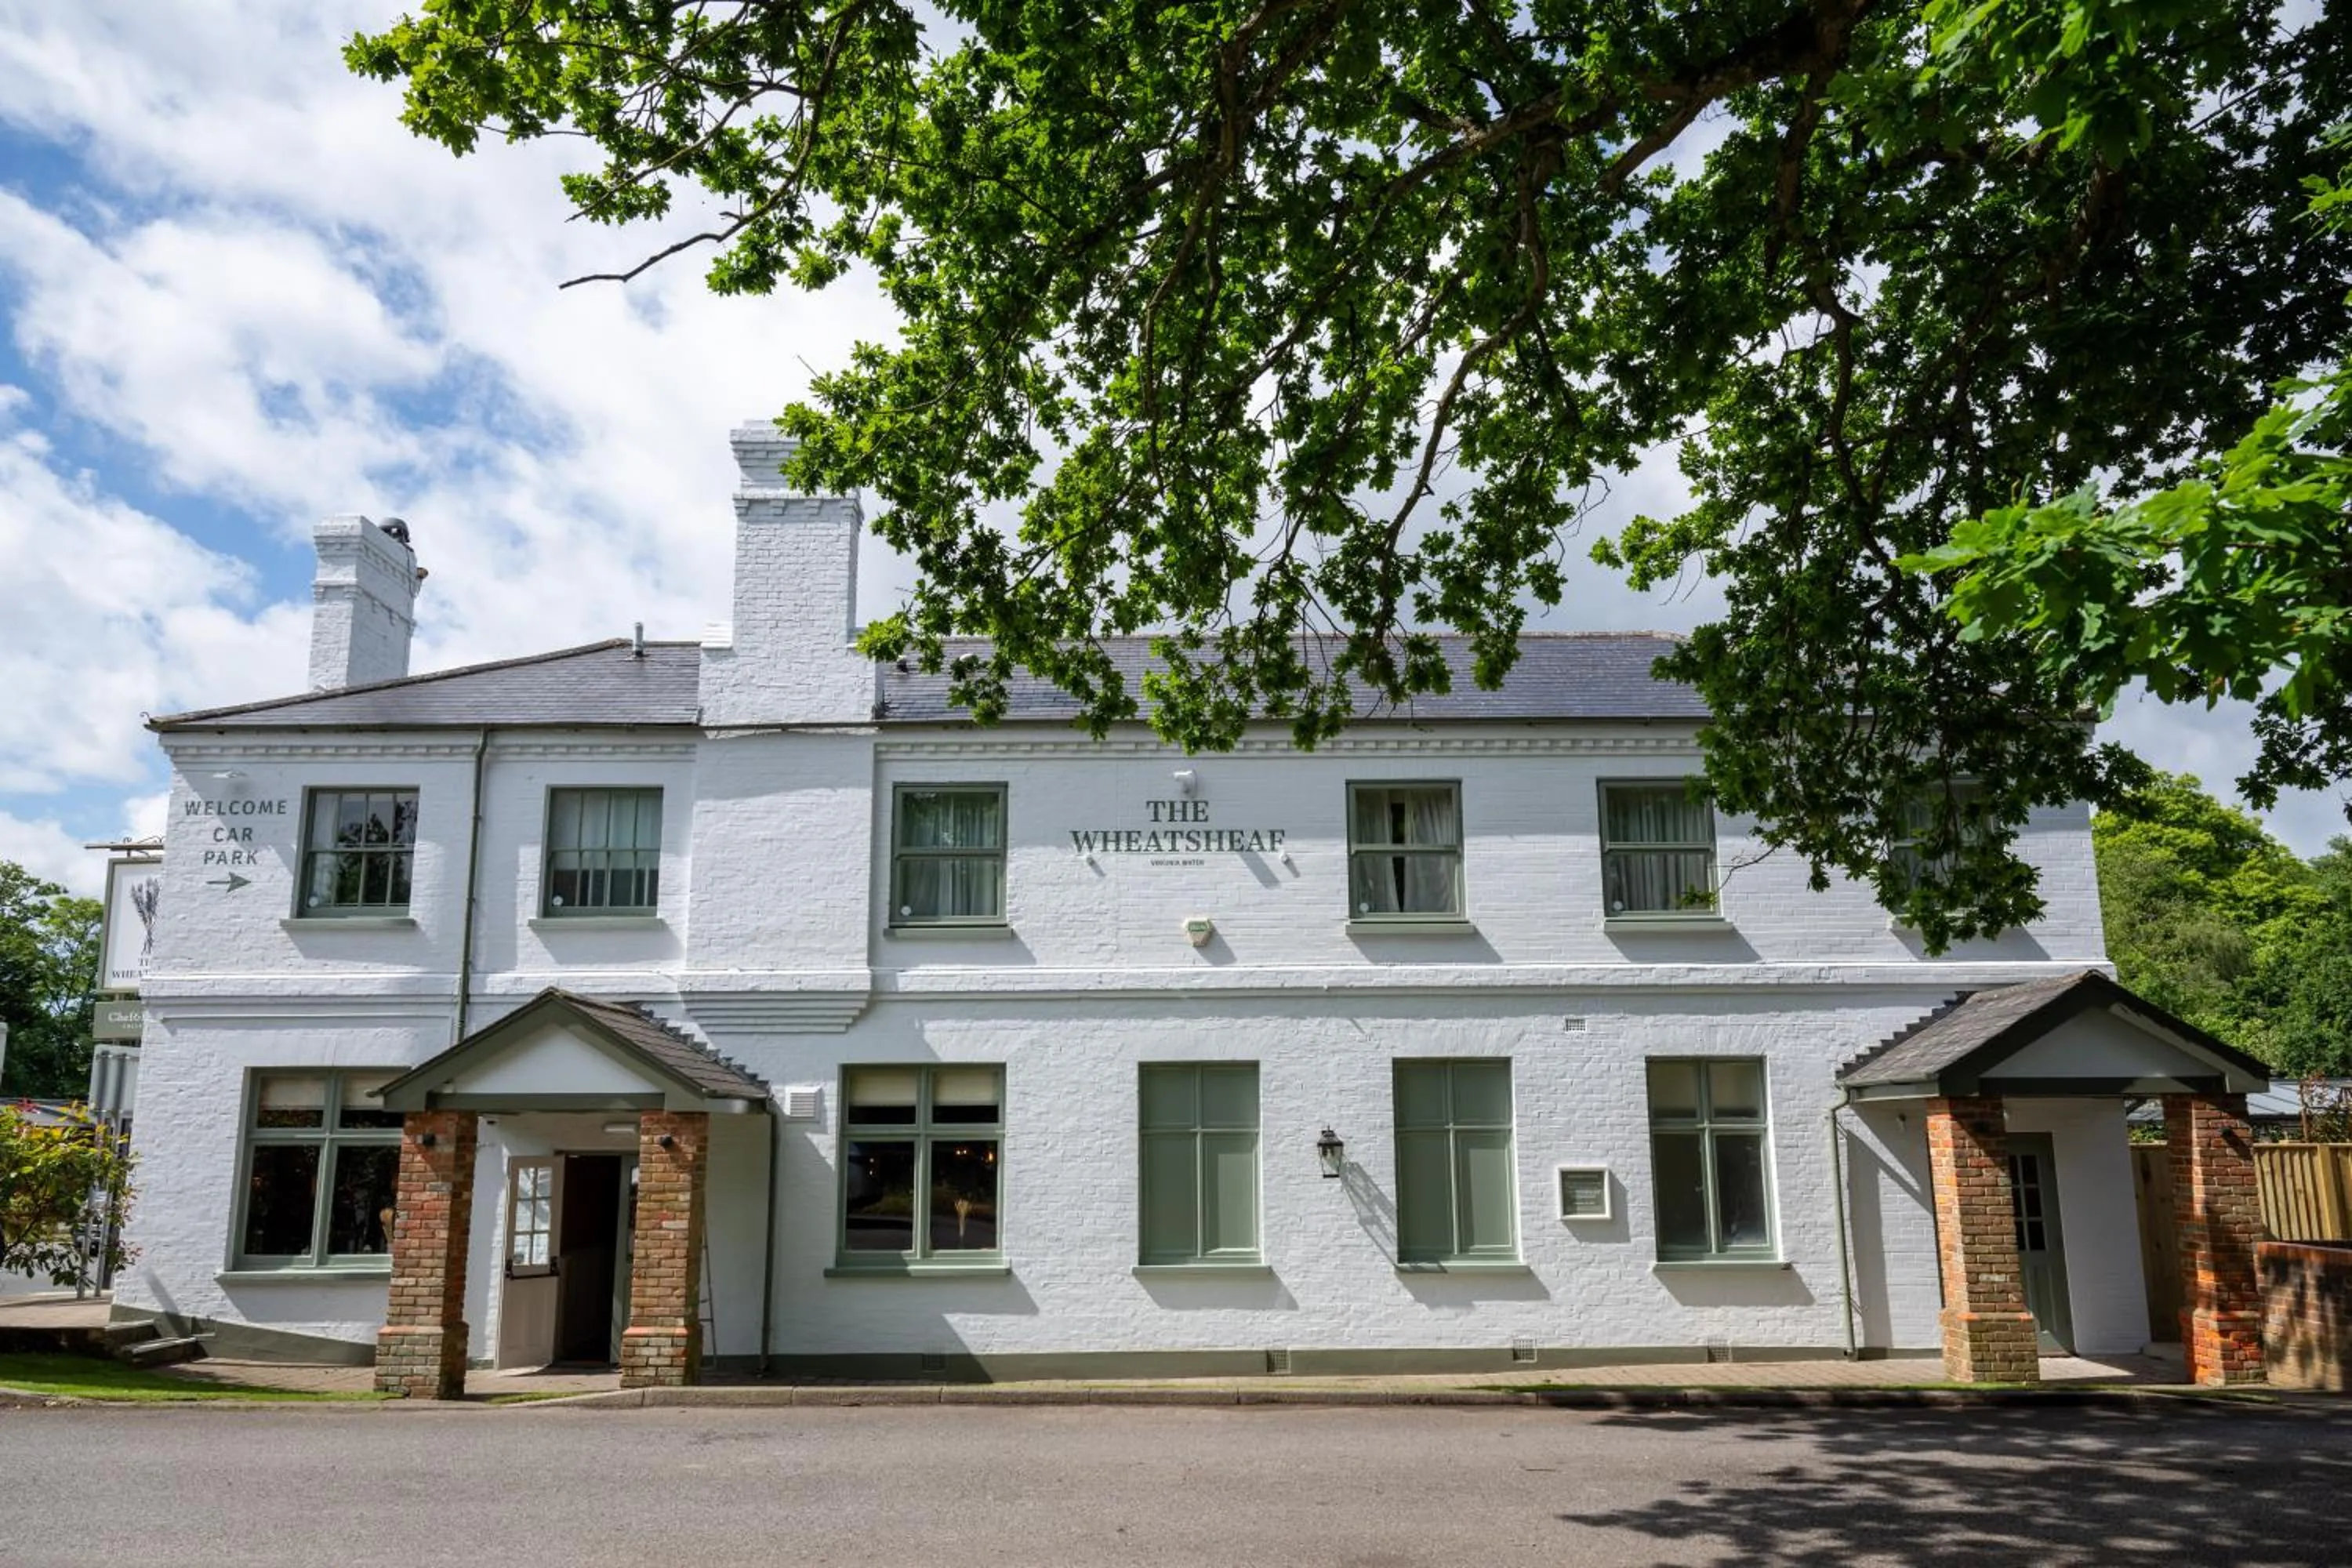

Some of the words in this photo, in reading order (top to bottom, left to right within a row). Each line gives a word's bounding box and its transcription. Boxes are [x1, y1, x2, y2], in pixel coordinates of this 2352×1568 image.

[184, 800, 287, 816] WELCOME
[1145, 800, 1209, 822] THE
[212, 827, 252, 842] CAR
[1069, 829, 1285, 853] WHEATSHEAF
[204, 851, 257, 865] PARK
